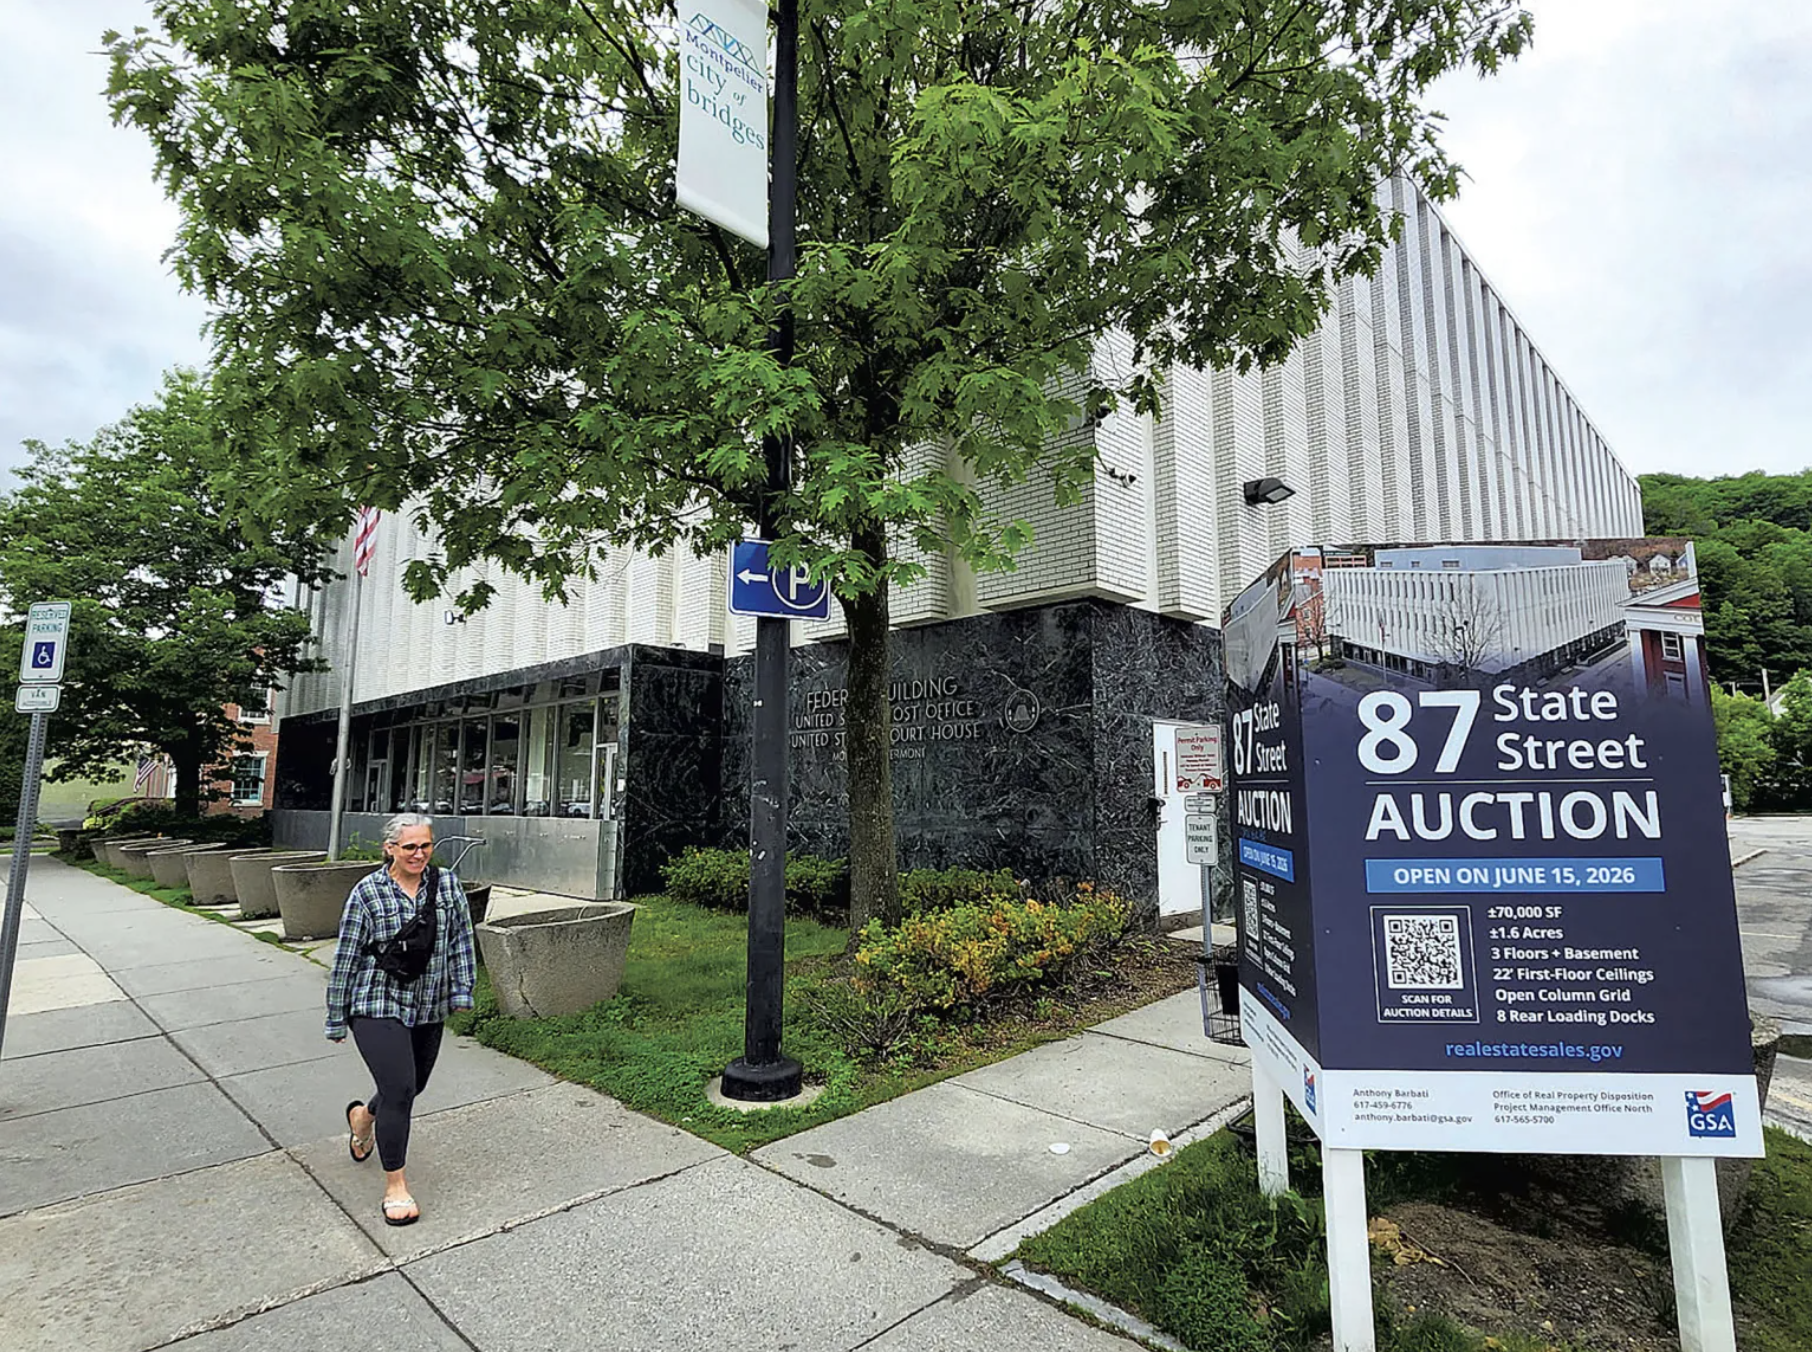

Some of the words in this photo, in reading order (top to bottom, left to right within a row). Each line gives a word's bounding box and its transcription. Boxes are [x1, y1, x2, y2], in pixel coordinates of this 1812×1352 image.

[685, 29, 763, 94] Montpelier
[686, 54, 727, 96] city
[733, 92, 746, 106] of
[687, 78, 765, 151] bridges
[32, 622, 63, 633] PARKING
[807, 688, 849, 709] FEDER
[888, 676, 959, 701] UILDING
[795, 713, 834, 729] UNITED
[893, 703, 920, 722] OST
[925, 700, 975, 719] OFFICE
[791, 732, 829, 748] UNITED
[890, 726, 925, 742] OURT
[931, 722, 984, 740] HOUSE
[1232, 708, 1253, 776] 87
[1253, 699, 1280, 733] State
[1356, 689, 1482, 775] 87
[1492, 684, 1619, 723] State
[890, 747, 926, 760] ERMONT
[1255, 739, 1288, 773] Street
[1496, 731, 1649, 771] Street
[1237, 790, 1293, 835] AUCTION
[1364, 790, 1662, 841] AUCTION
[1188, 823, 1211, 832] TENANT
[1187, 835, 1213, 843] PARKING
[1393, 867, 1450, 885] OPEN
[1455, 867, 1490, 884] ON
[1492, 867, 1546, 888] JUNE
[1551, 866, 1582, 887] 15,
[1585, 866, 1636, 885] 2026
[1487, 906, 1543, 920] ±70,000
[1545, 906, 1563, 919] SF
[1489, 926, 1520, 940] ±1.6
[1522, 926, 1564, 940] Acres
[1490, 947, 1501, 960] 3
[1503, 946, 1550, 960] Floors
[1551, 949, 1562, 959] +
[1563, 947, 1640, 960] Basement
[1516, 967, 1593, 981] First-Floor
[1595, 967, 1655, 984] Ceilings
[1401, 994, 1430, 1005] SCAN
[1431, 994, 1453, 1005] FOR
[1495, 988, 1536, 1005] Open
[1537, 988, 1597, 1002] Column
[1599, 988, 1632, 1002] Grid
[1383, 1007, 1430, 1018] AUCTION
[1431, 1007, 1473, 1018] DETAILS
[1496, 1010, 1507, 1023] 8
[1509, 1010, 1545, 1023] Rear
[1547, 1009, 1608, 1026] Loading
[1609, 1009, 1656, 1024] Docks
[1445, 1040, 1624, 1063] realestatesales.gov
[1353, 1088, 1393, 1099] Anthony
[1394, 1089, 1430, 1098] Barbati
[1492, 1090, 1521, 1100] Office
[1522, 1090, 1533, 1100] of
[1534, 1091, 1556, 1100] Real
[1557, 1091, 1599, 1102] Property
[1600, 1091, 1655, 1101] Disposition
[1353, 1101, 1413, 1110] 617-459-6776
[1494, 1103, 1528, 1114] Project
[1529, 1103, 1592, 1115] Management
[1593, 1103, 1623, 1113] Office
[1624, 1104, 1654, 1114] North
[1354, 1113, 1474, 1125] anthony.barbati@gsa.gov
[1494, 1115, 1556, 1124] 617-565-5700
[1689, 1112, 1734, 1131] GSA
